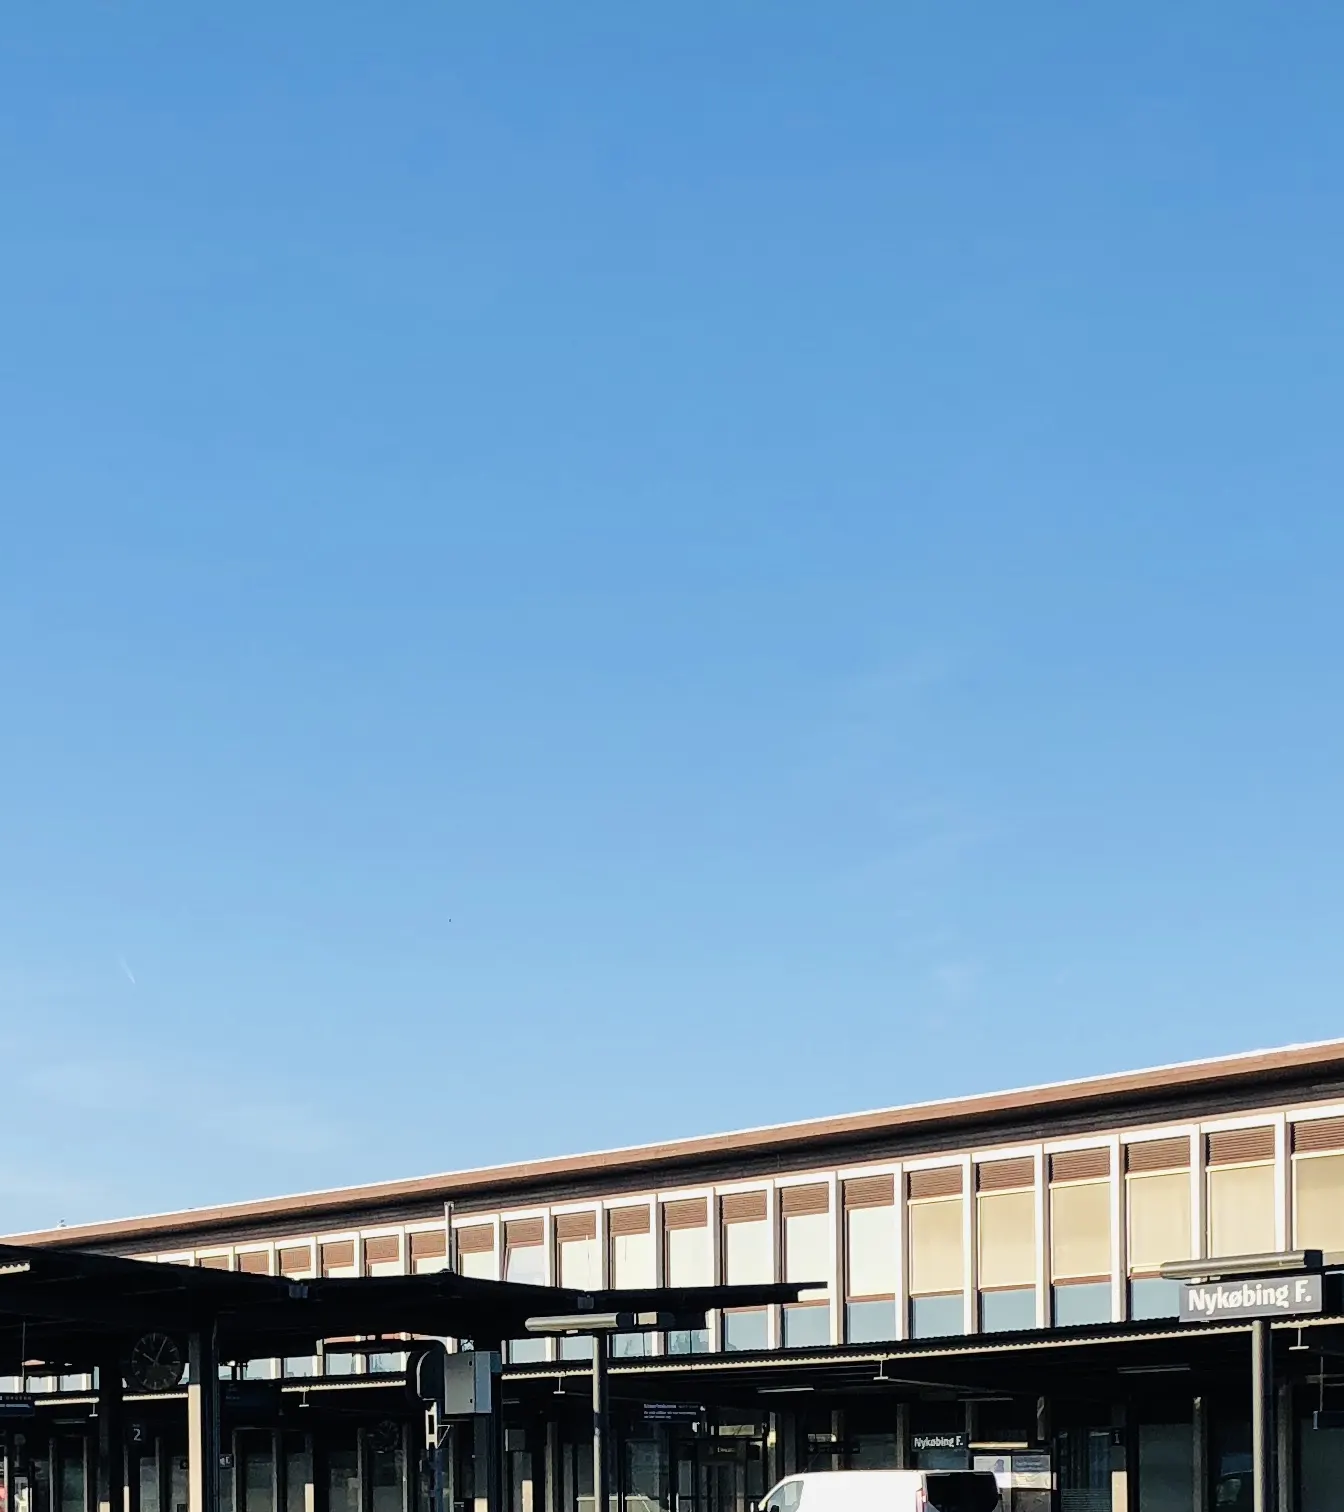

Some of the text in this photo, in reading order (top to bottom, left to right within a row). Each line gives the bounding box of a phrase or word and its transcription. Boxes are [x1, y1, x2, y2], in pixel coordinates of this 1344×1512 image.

[1188, 1279, 1312, 1315] Nykøbing F.
[133, 1428, 142, 1441] 2
[956, 1435, 963, 1446] F.
